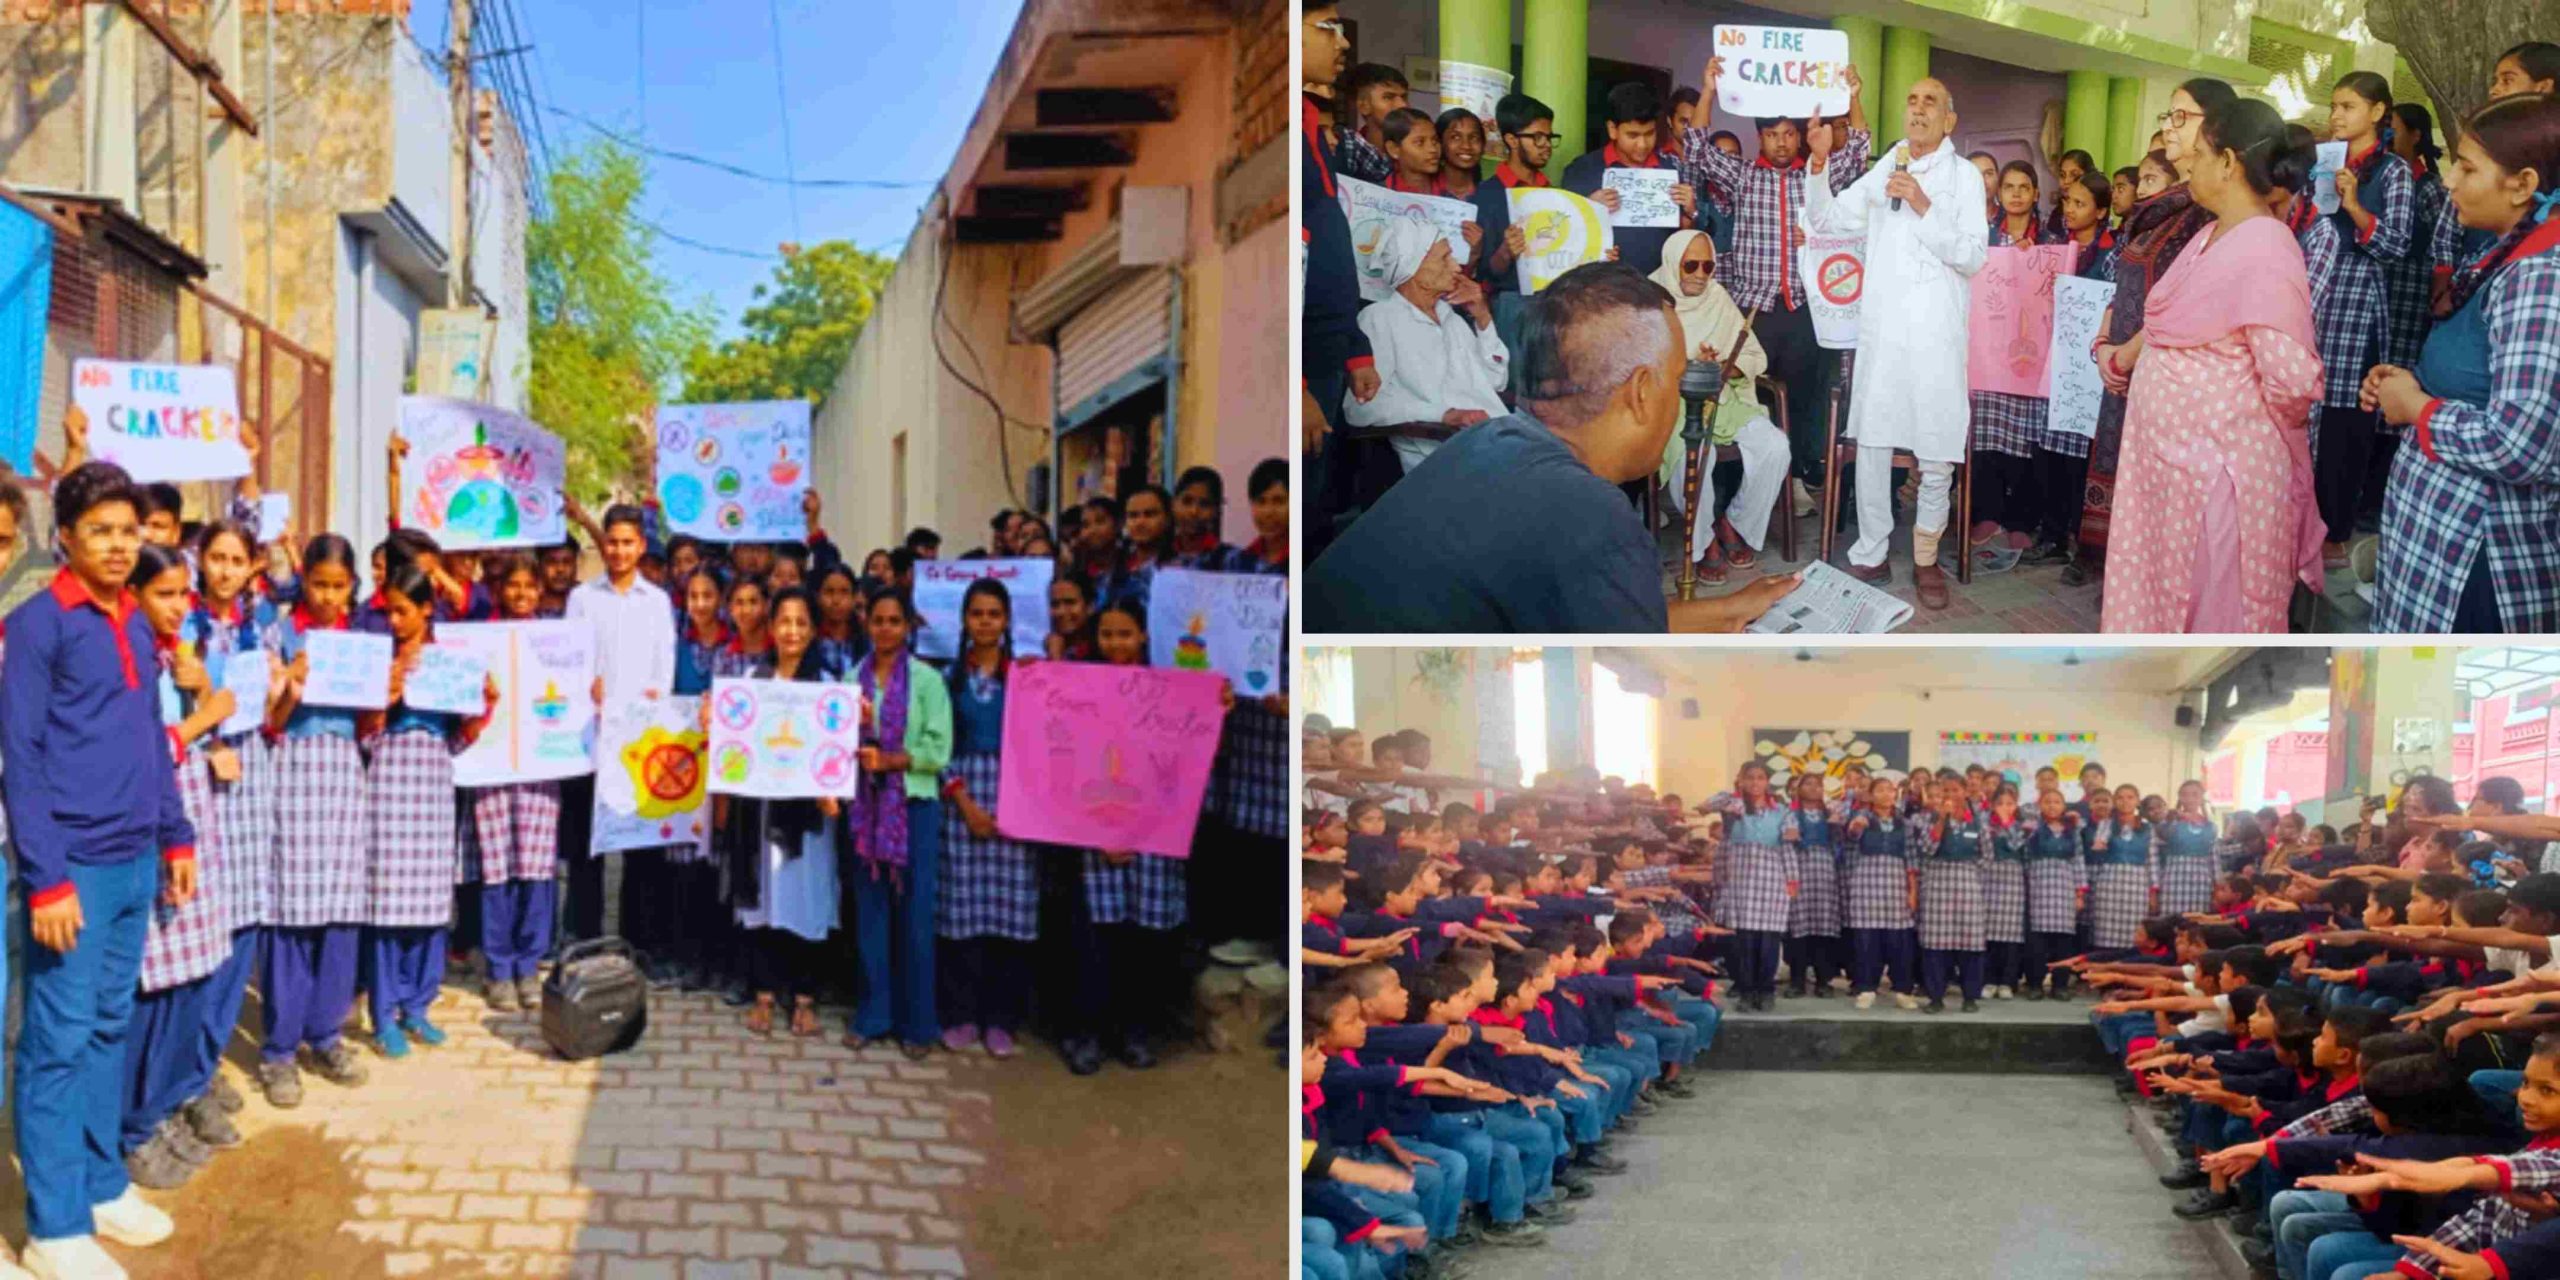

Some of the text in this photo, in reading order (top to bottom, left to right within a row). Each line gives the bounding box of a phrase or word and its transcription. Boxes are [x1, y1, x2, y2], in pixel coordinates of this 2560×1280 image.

[1719, 29, 1804, 51] NO FIRE
[1738, 59, 1847, 92] CRACKER
[130, 368, 180, 395] FIRE
[107, 403, 235, 443] CRACKER
